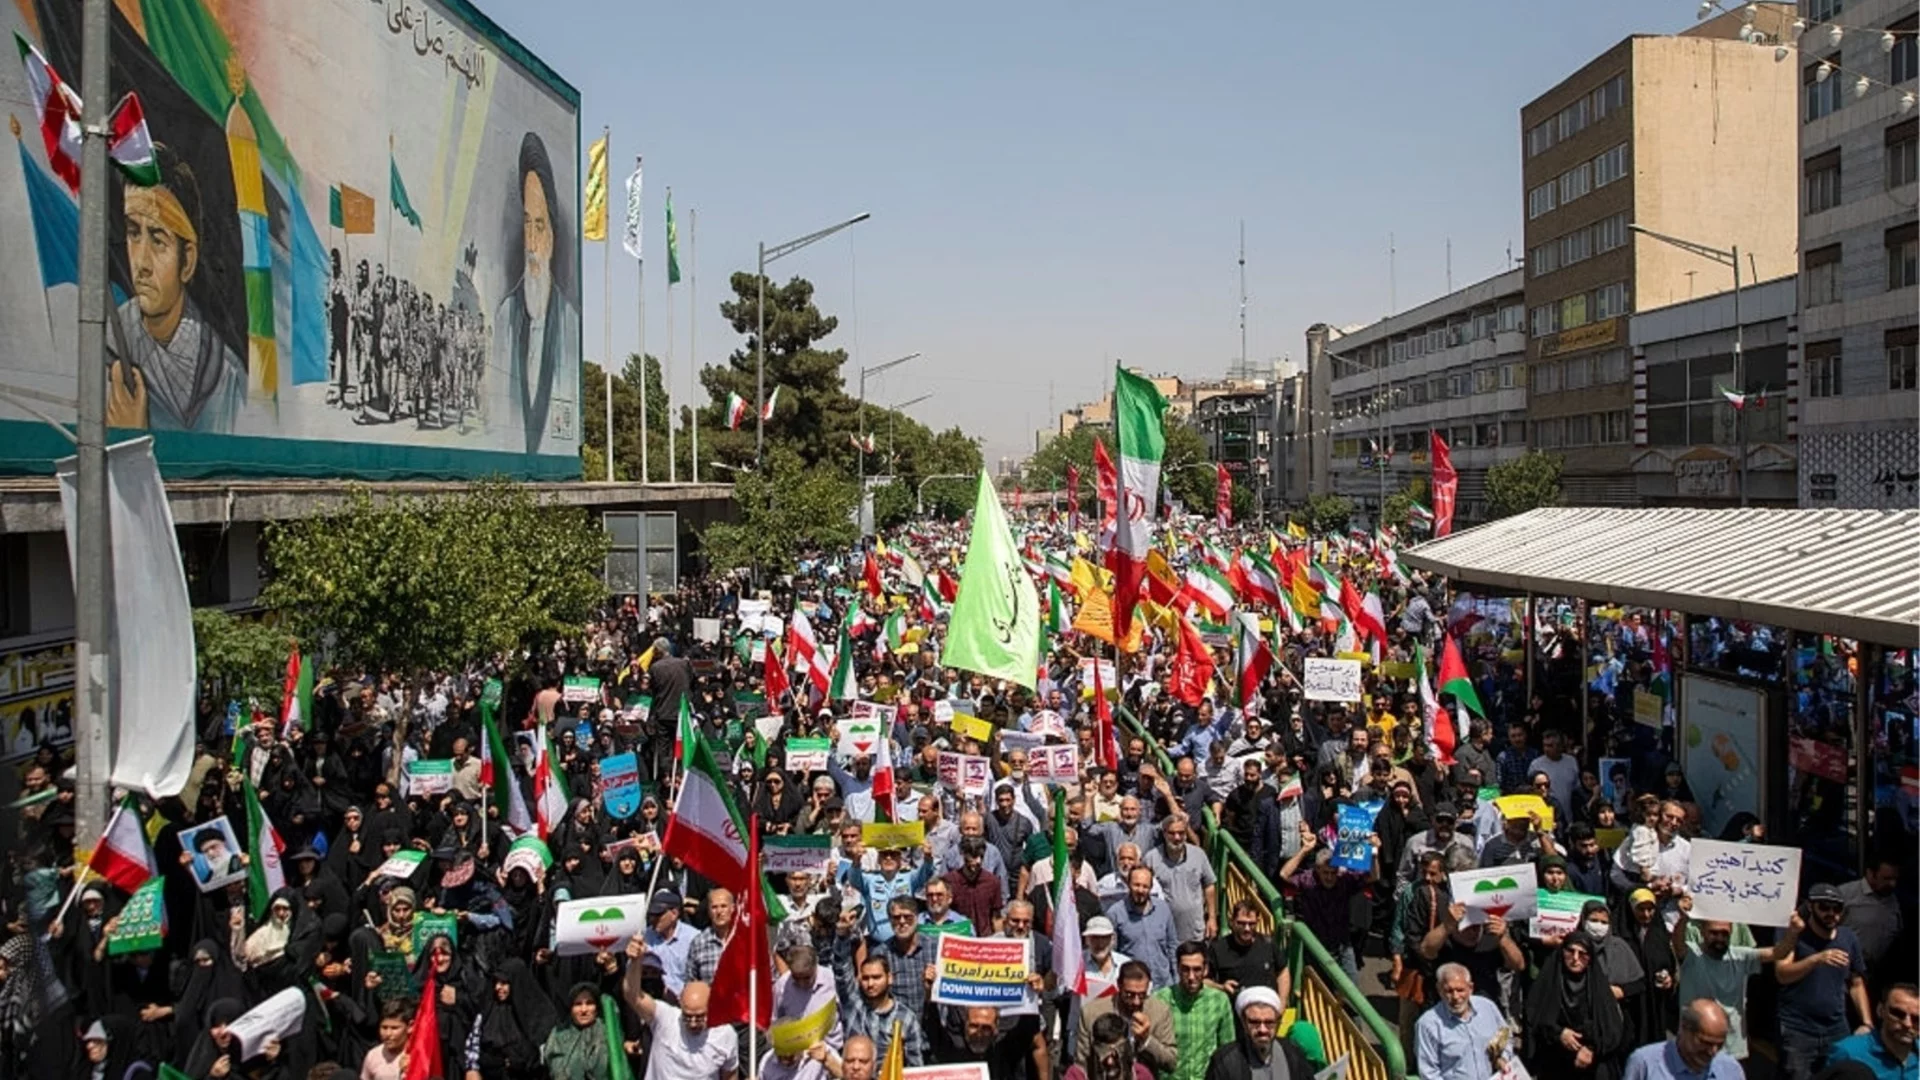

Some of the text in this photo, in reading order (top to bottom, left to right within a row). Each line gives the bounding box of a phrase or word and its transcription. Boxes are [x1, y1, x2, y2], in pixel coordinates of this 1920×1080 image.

[941, 982, 1022, 998] DOWN WITH USA
